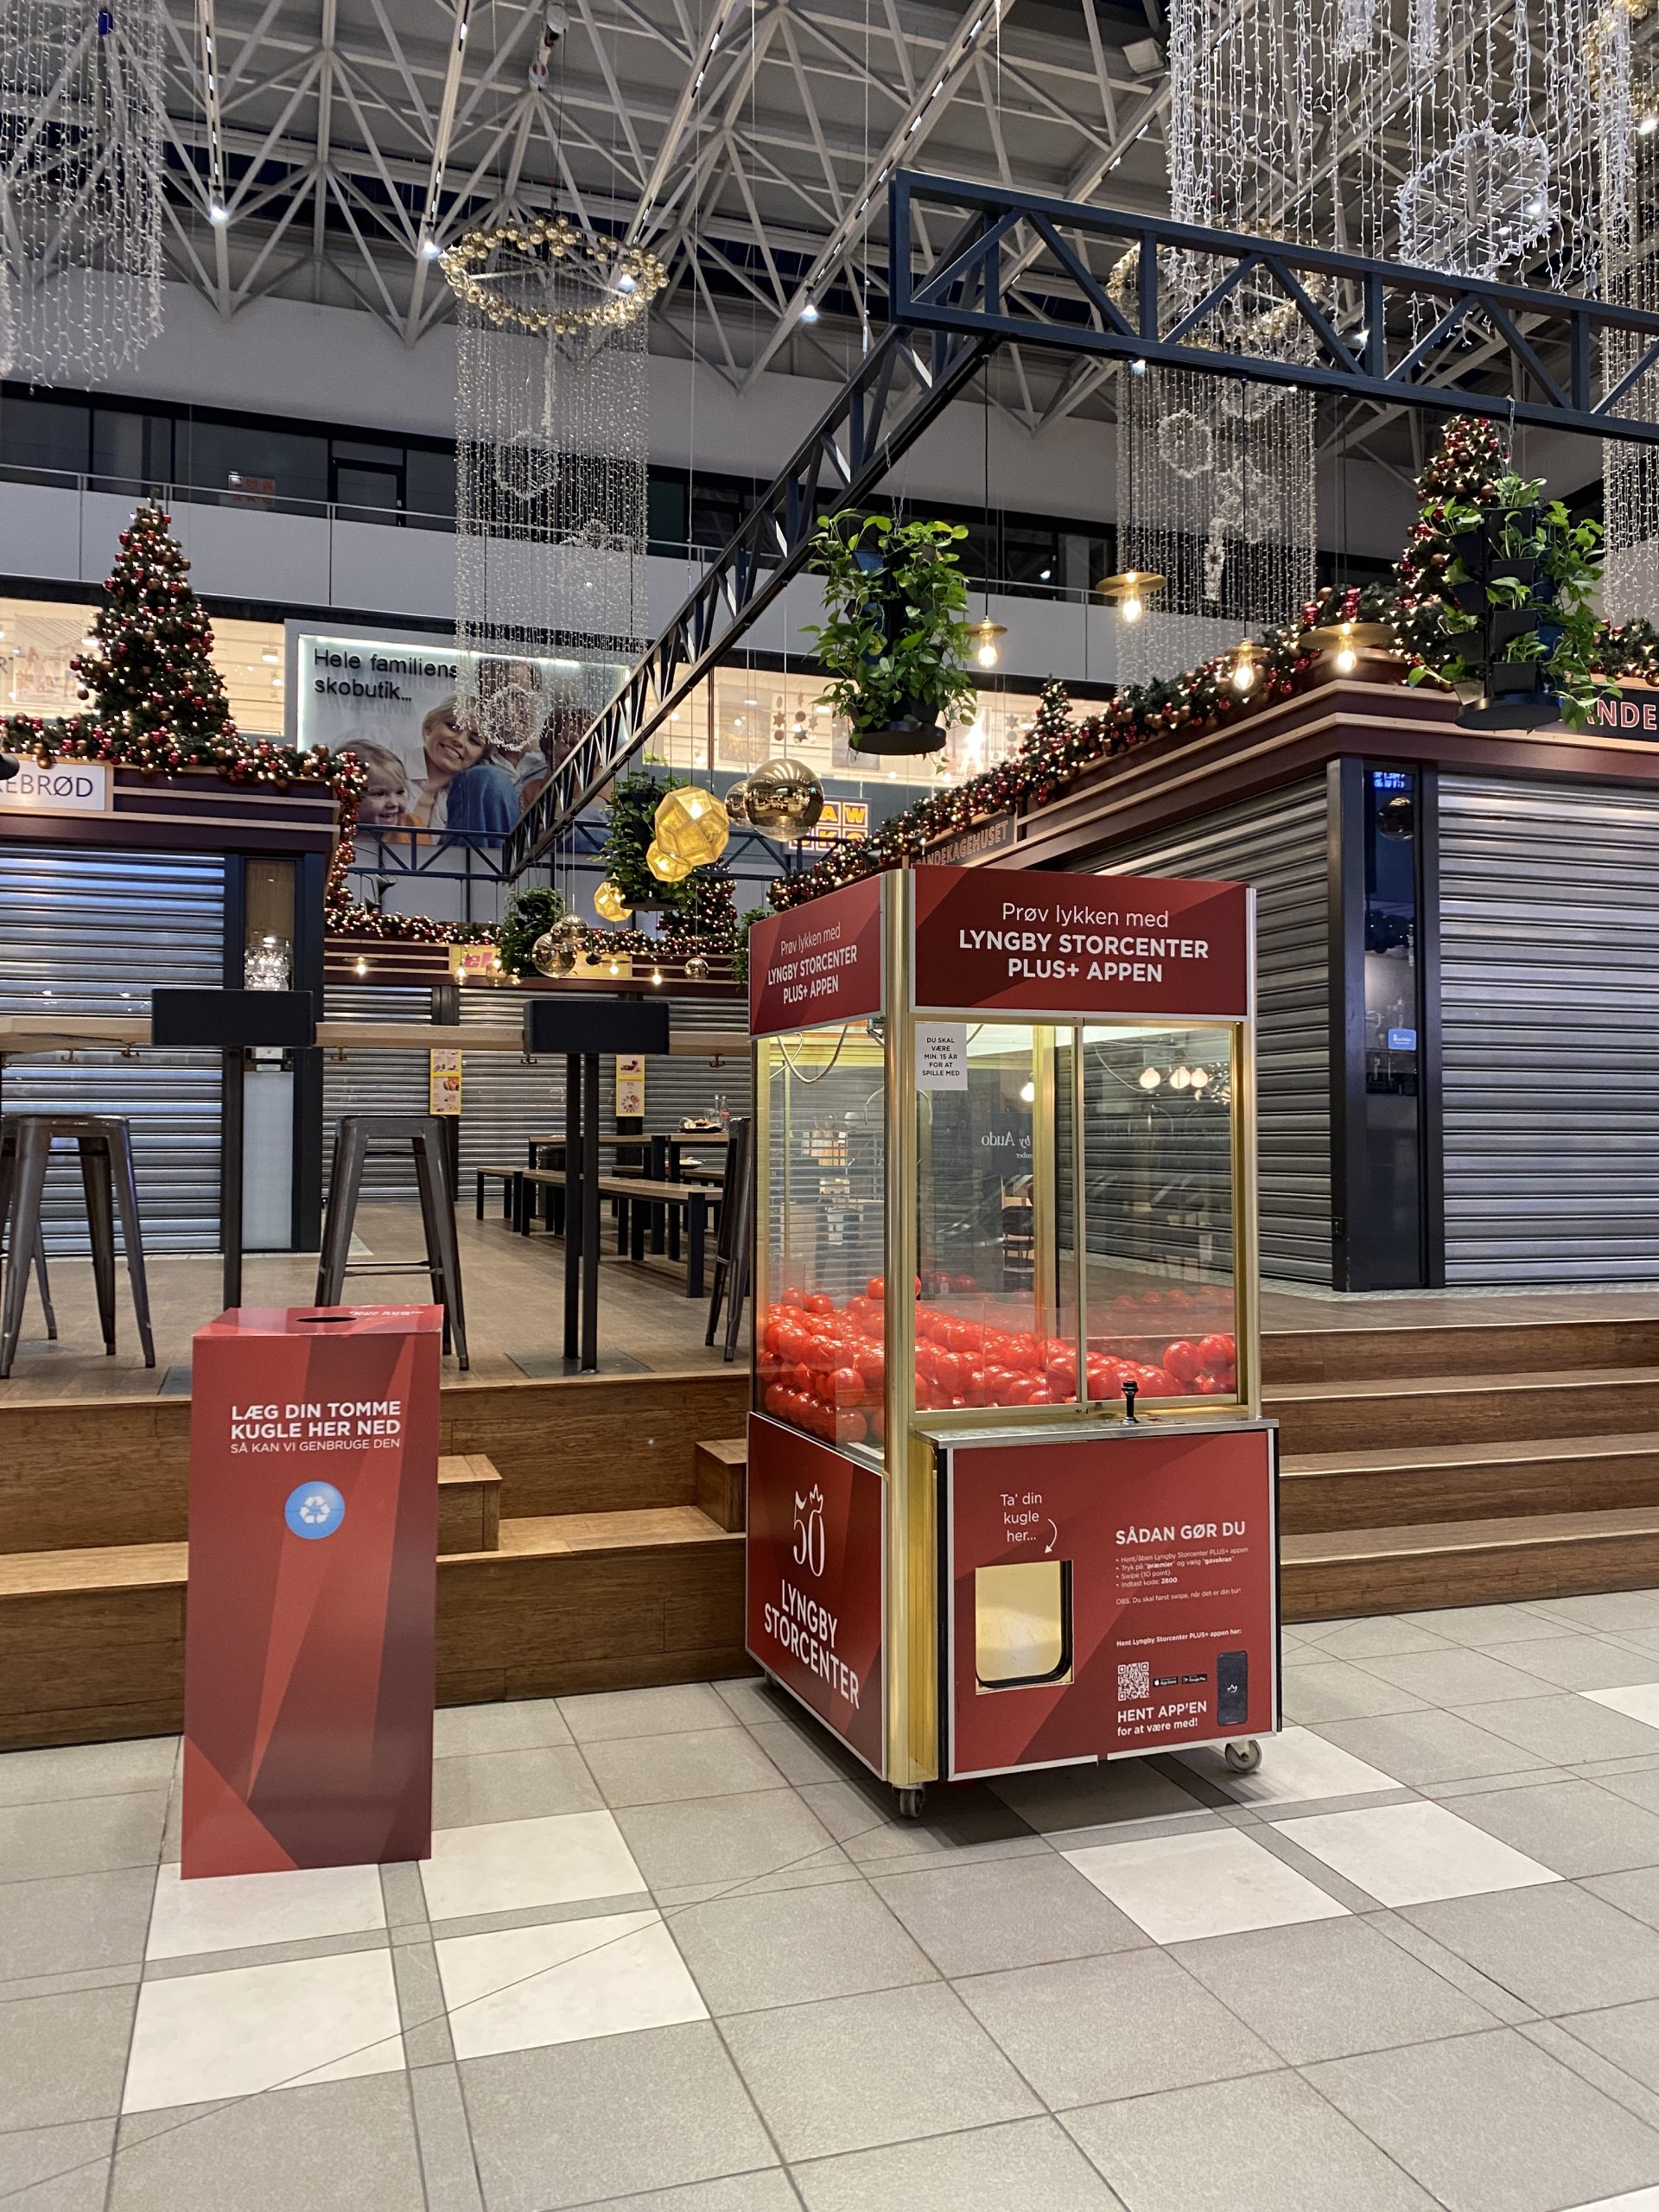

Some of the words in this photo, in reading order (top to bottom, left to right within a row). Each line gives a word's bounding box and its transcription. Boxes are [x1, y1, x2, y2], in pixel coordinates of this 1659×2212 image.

[314, 648, 361, 670] Hele
[371, 653, 457, 678] familiens
[314, 677, 412, 702] skobutik...
[1573, 700, 1658, 730] NDE
[0, 773, 93, 797] EBRØD
[1002, 902, 1049, 922] Prøv
[1056, 905, 1119, 926] lykken
[1126, 911, 1169, 928] med
[780, 940, 797, 956] Prøv
[798, 931, 822, 953] lykken
[823, 921, 841, 942] med
[959, 929, 1052, 952] LYNGBY
[1058, 934, 1209, 959] STORCENTER
[768, 962, 798, 985] LYNGBY
[800, 944, 857, 977] STORCENTER
[1007, 957, 1079, 979] PLUS+
[1086, 962, 1162, 982] APPEN
[783, 984, 808, 1004] PLUS+
[810, 975, 839, 998] APPEN
[232, 1404, 279, 1421] LÆG
[285, 1403, 321, 1419] DIN
[327, 1401, 401, 1418] TOMME
[231, 1422, 302, 1440] KUGLE
[308, 1421, 350, 1437] HER
[358, 1420, 401, 1435] NED
[231, 1441, 248, 1454] SÅ
[252, 1443, 280, 1453] KAN
[283, 1441, 296, 1452] VI
[299, 1439, 370, 1452] GENBRUGE
[373, 1438, 401, 1449] DEN
[1001, 1493, 1018, 1506] Ta'
[1022, 1492, 1042, 1504] din
[1004, 1510, 1039, 1526] kugle
[793, 1484, 825, 1577] 50
[1007, 1529, 1037, 1542] her...
[1116, 1526, 1175, 1545] SÅDAN
[1180, 1523, 1217, 1540] GØR
[1223, 1521, 1245, 1536] DU
[1177, 1550, 1209, 1559] Storcenter
[781, 1580, 838, 1649] LYNGBY
[1133, 1637, 1155, 1645] Lyngby
[1156, 1634, 1188, 1643] Storcenter
[764, 1603, 860, 1710] STORCENTER
[1117, 1707, 1154, 1723] HENT
[1158, 1700, 1207, 1719] APP'EN
[1117, 1726, 1133, 1737] for
[1134, 1724, 1145, 1734] at
[1147, 1722, 1172, 1732] være
[1173, 1718, 1198, 1729] med!
